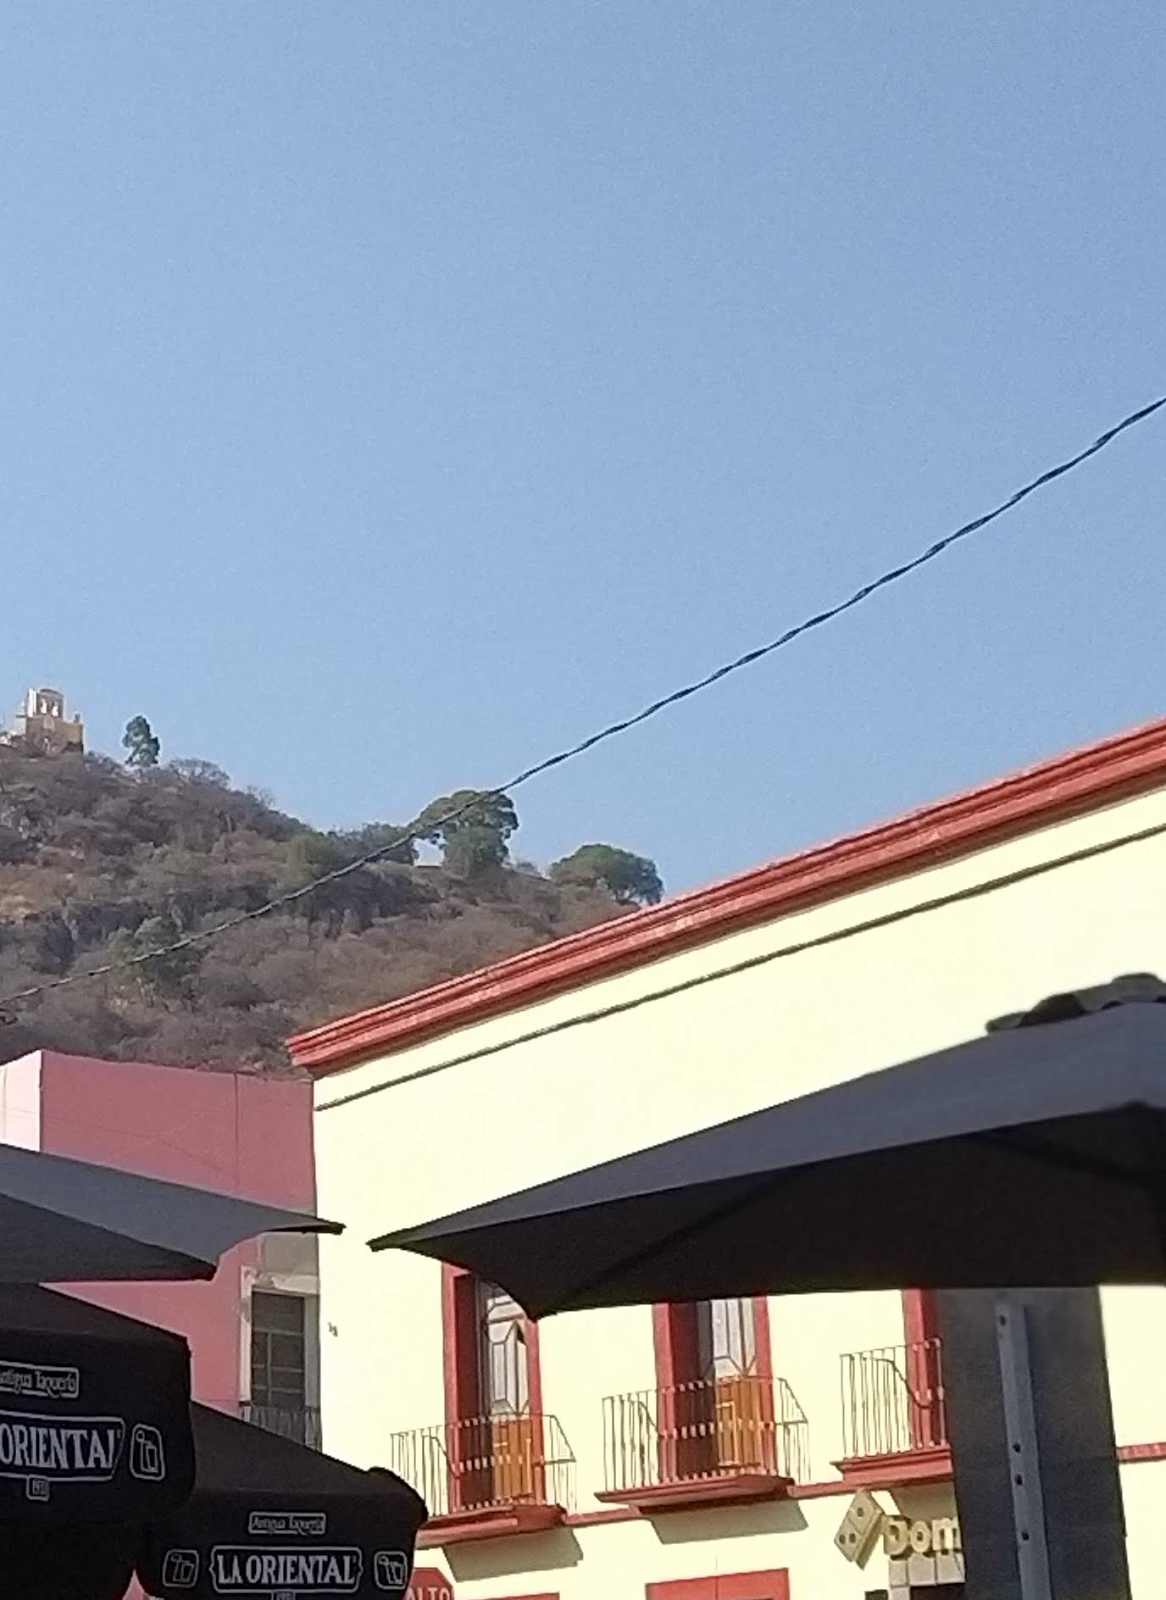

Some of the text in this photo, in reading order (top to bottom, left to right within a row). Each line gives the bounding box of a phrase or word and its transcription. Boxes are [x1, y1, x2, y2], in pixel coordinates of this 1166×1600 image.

[882, 1515, 962, 1555] Dom
[217, 1554, 356, 1584] LA ORIENTAL
